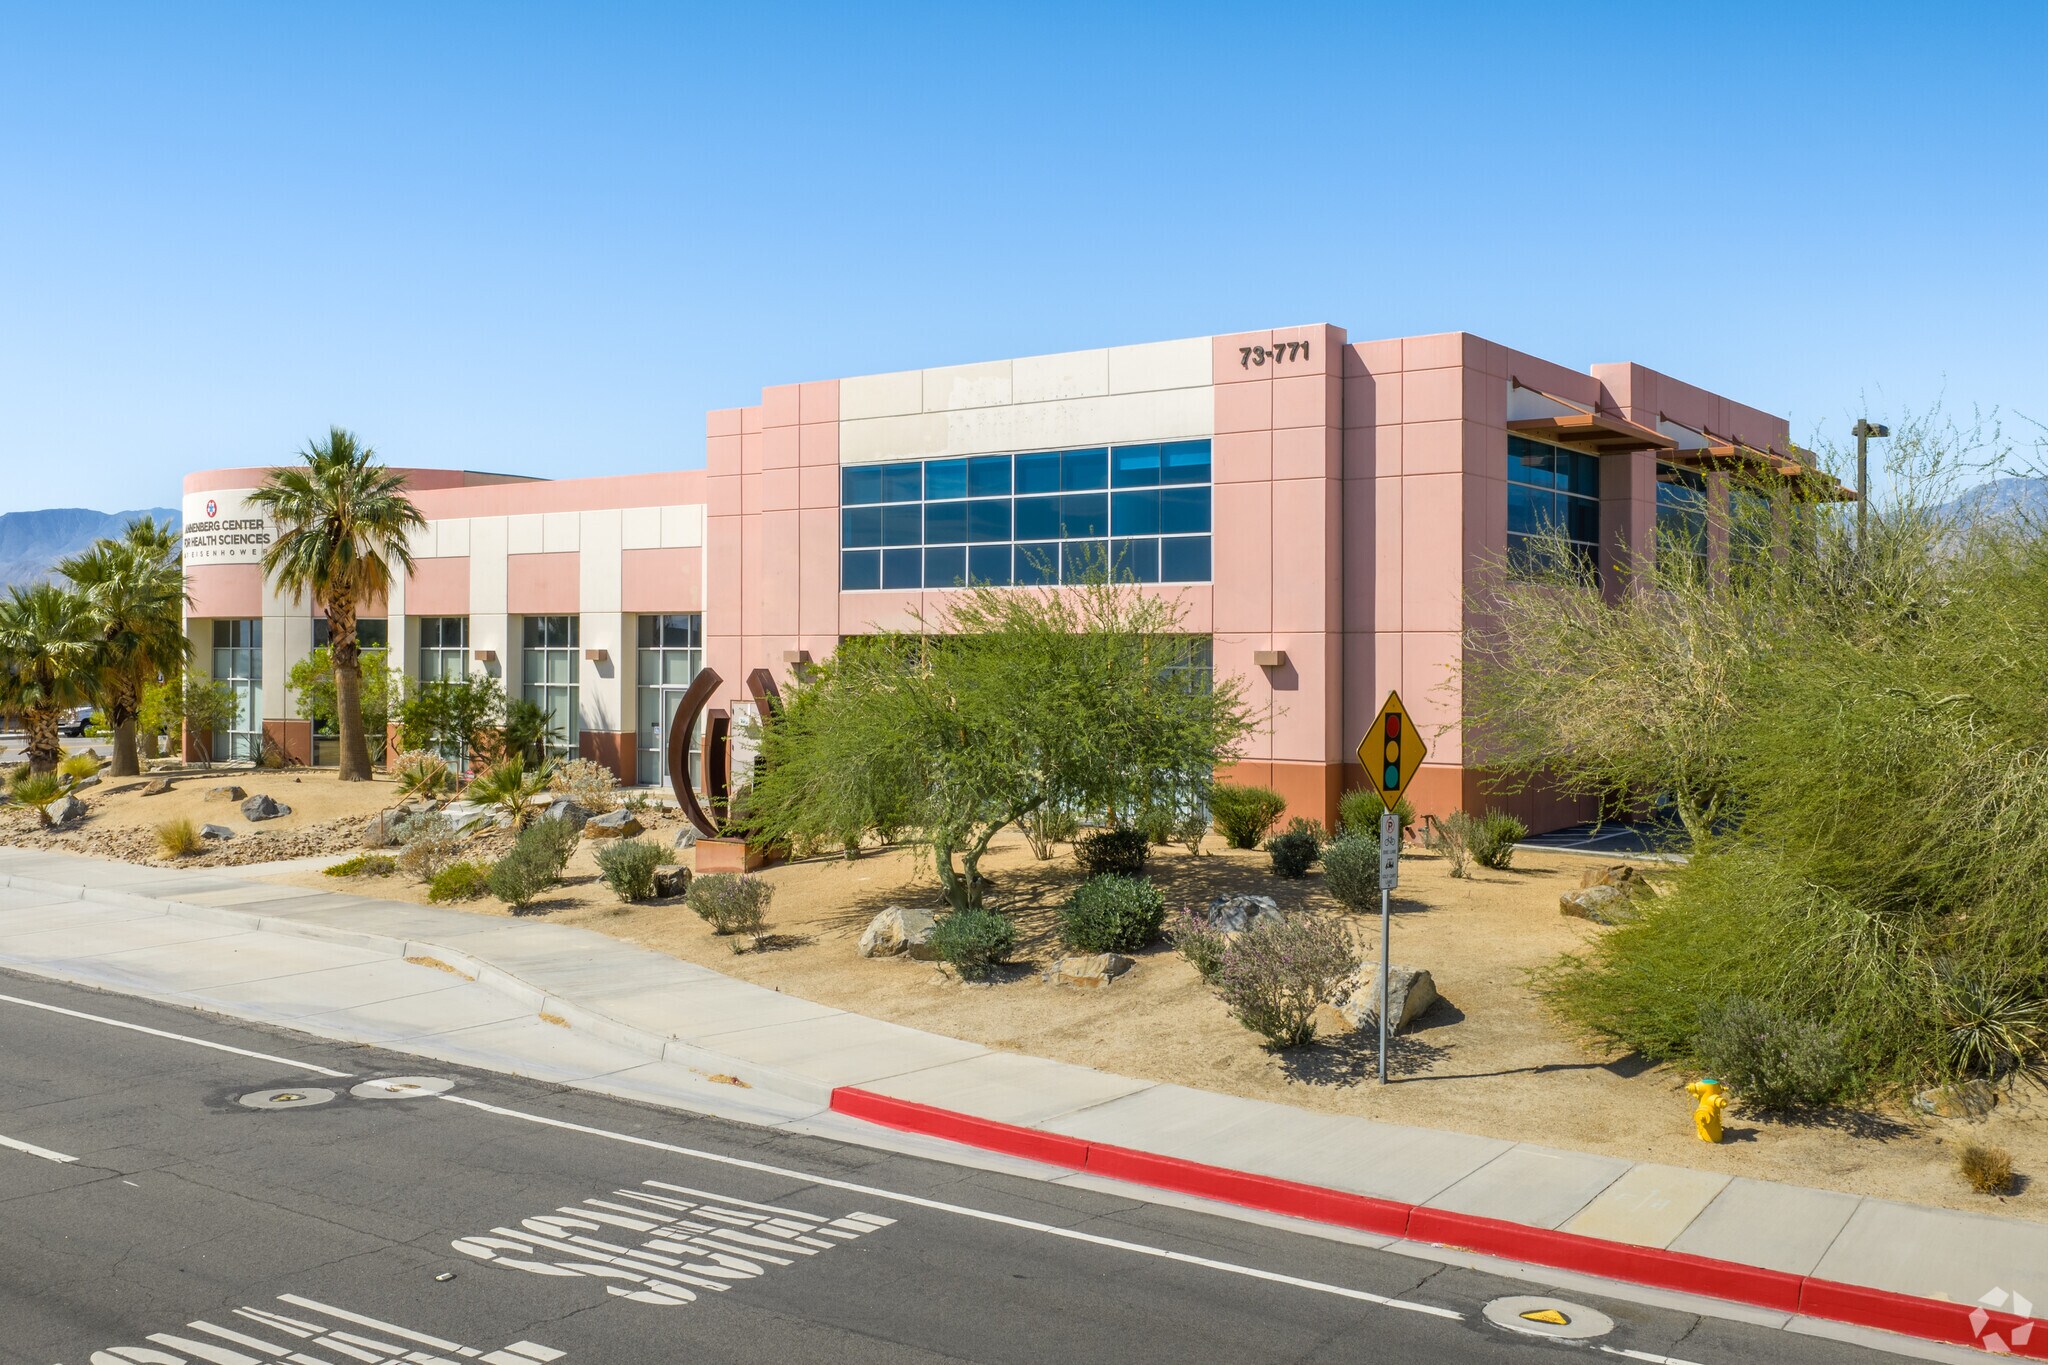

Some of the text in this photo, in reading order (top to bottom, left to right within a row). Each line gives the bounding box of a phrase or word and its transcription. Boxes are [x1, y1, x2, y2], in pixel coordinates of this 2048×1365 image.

[1239, 340, 1309, 370] 73-771
[222, 519, 264, 530] CENTER
[192, 535, 217, 547] HEALTH
[218, 533, 271, 545] SCIENCES
[191, 548, 268, 559] EISENHOWER
[450, 1179, 898, 1306] SIGNAL
